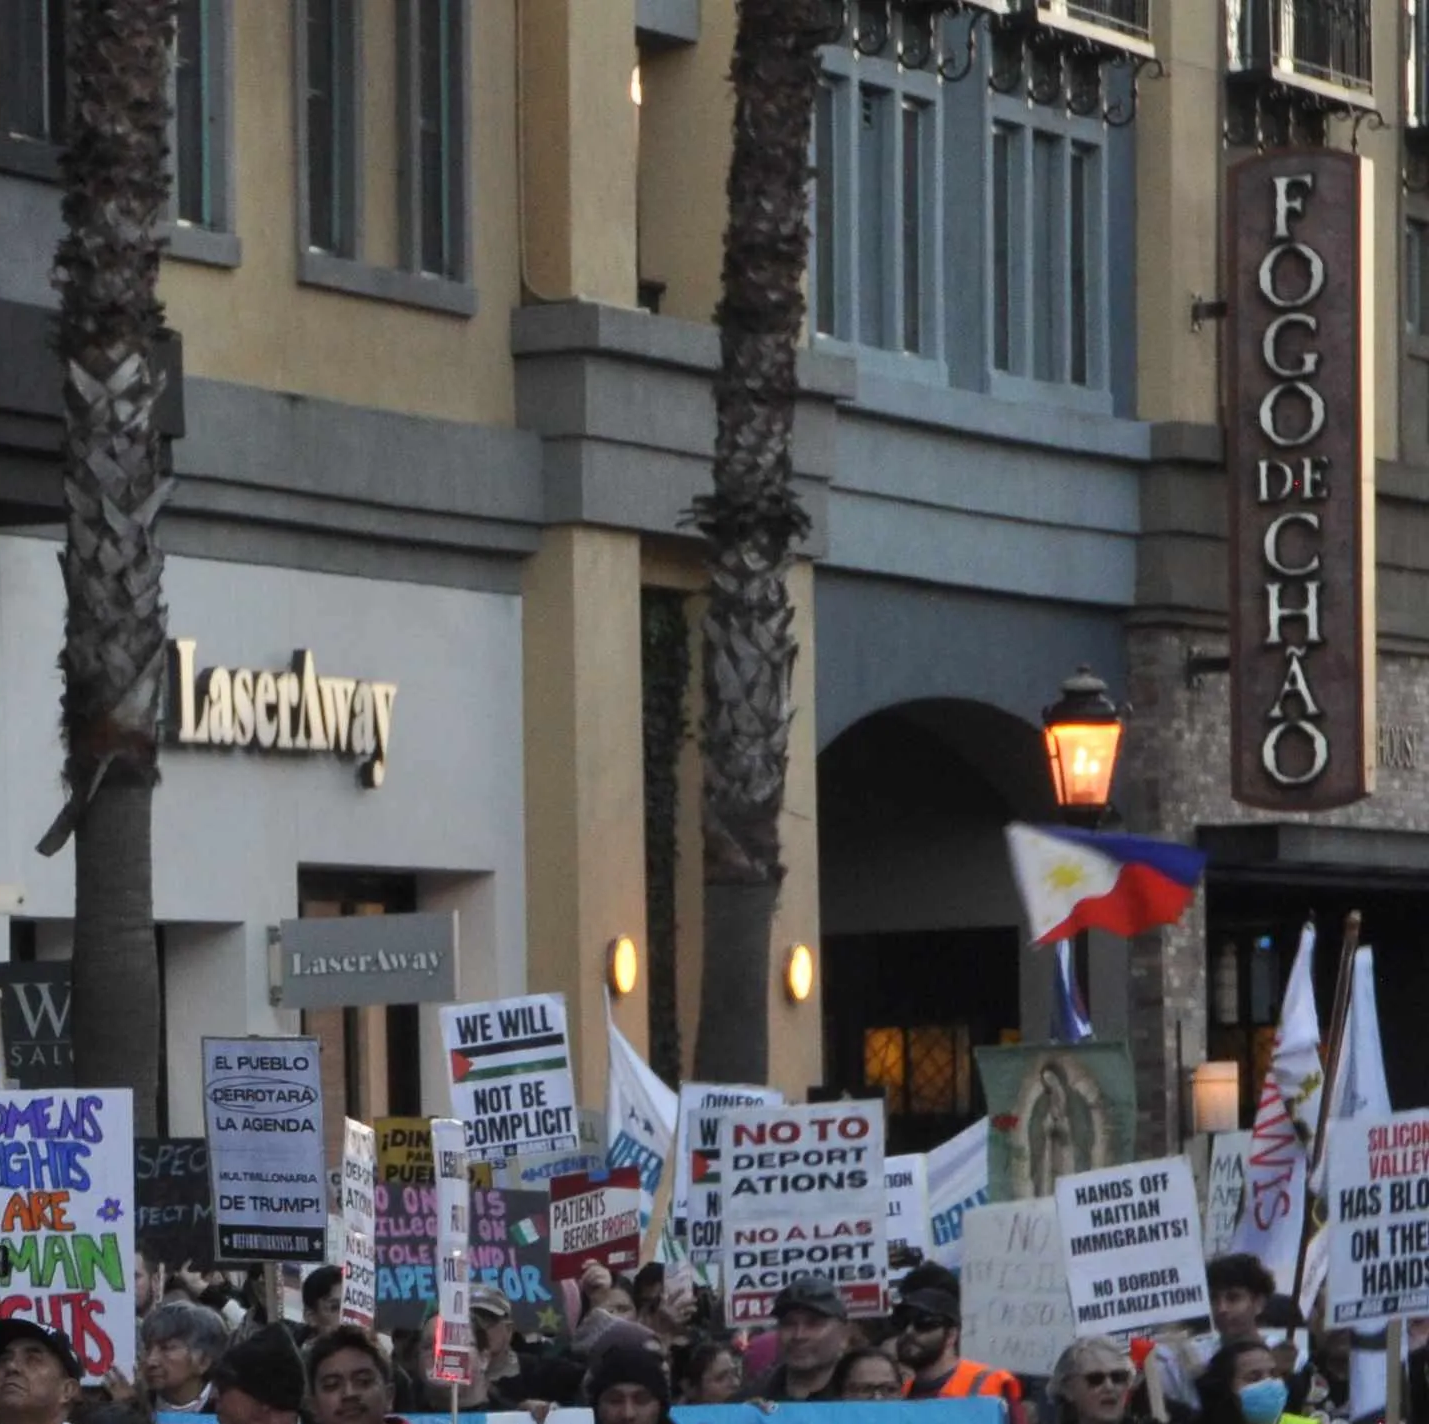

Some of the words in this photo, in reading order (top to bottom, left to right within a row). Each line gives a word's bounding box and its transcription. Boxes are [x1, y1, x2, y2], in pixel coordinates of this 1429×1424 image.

[1258, 174, 1325, 445] FOGO
[1258, 456, 1331, 501] DE
[1261, 511, 1329, 785] CHÃO
[169, 637, 397, 788] LaserAway
[292, 950, 442, 978] LaserAway
[456, 1014, 493, 1045] WE
[498, 1005, 553, 1039] WILL
[216, 1056, 232, 1071] EL
[237, 1056, 309, 1071] PUEBLO
[474, 1085, 514, 1116] NOT
[520, 1081, 547, 1109] BE
[216, 1117, 237, 1131] LA
[242, 1117, 316, 1133] AGENDA
[462, 1107, 573, 1147] COMPLICIT
[732, 1121, 801, 1148] NO
[808, 1116, 870, 1144] TO
[732, 1147, 868, 1172] DEPORT
[731, 1169, 869, 1197] ATIONS
[1074, 1176, 1134, 1206] HANDS
[1140, 1172, 1170, 1195] OFF
[1, 1191, 76, 1233] ARE
[220, 1195, 245, 1211] DE
[253, 1197, 321, 1213] TRUMP!
[475, 1190, 506, 1217] IS
[553, 1192, 606, 1230] PATIENTS
[1090, 1199, 1160, 1228] HAITIAN
[1341, 1186, 1382, 1222] HAS
[479, 1219, 507, 1241] ON
[562, 1219, 600, 1252] BEFORE
[601, 1209, 639, 1240] PROFITS
[734, 1226, 778, 1245] NO
[784, 1224, 807, 1241] A
[813, 1221, 873, 1240] LAS
[1071, 1218, 1189, 1257] IMMIGRANTS!
[1352, 1229, 1381, 1263] ON
[734, 1242, 875, 1269] DEPORT
[734, 1263, 876, 1290] ACIONES
[1093, 1279, 1114, 1298] NO
[1118, 1267, 1180, 1296] BORDER
[1078, 1285, 1203, 1323] MILITARIZATION!
